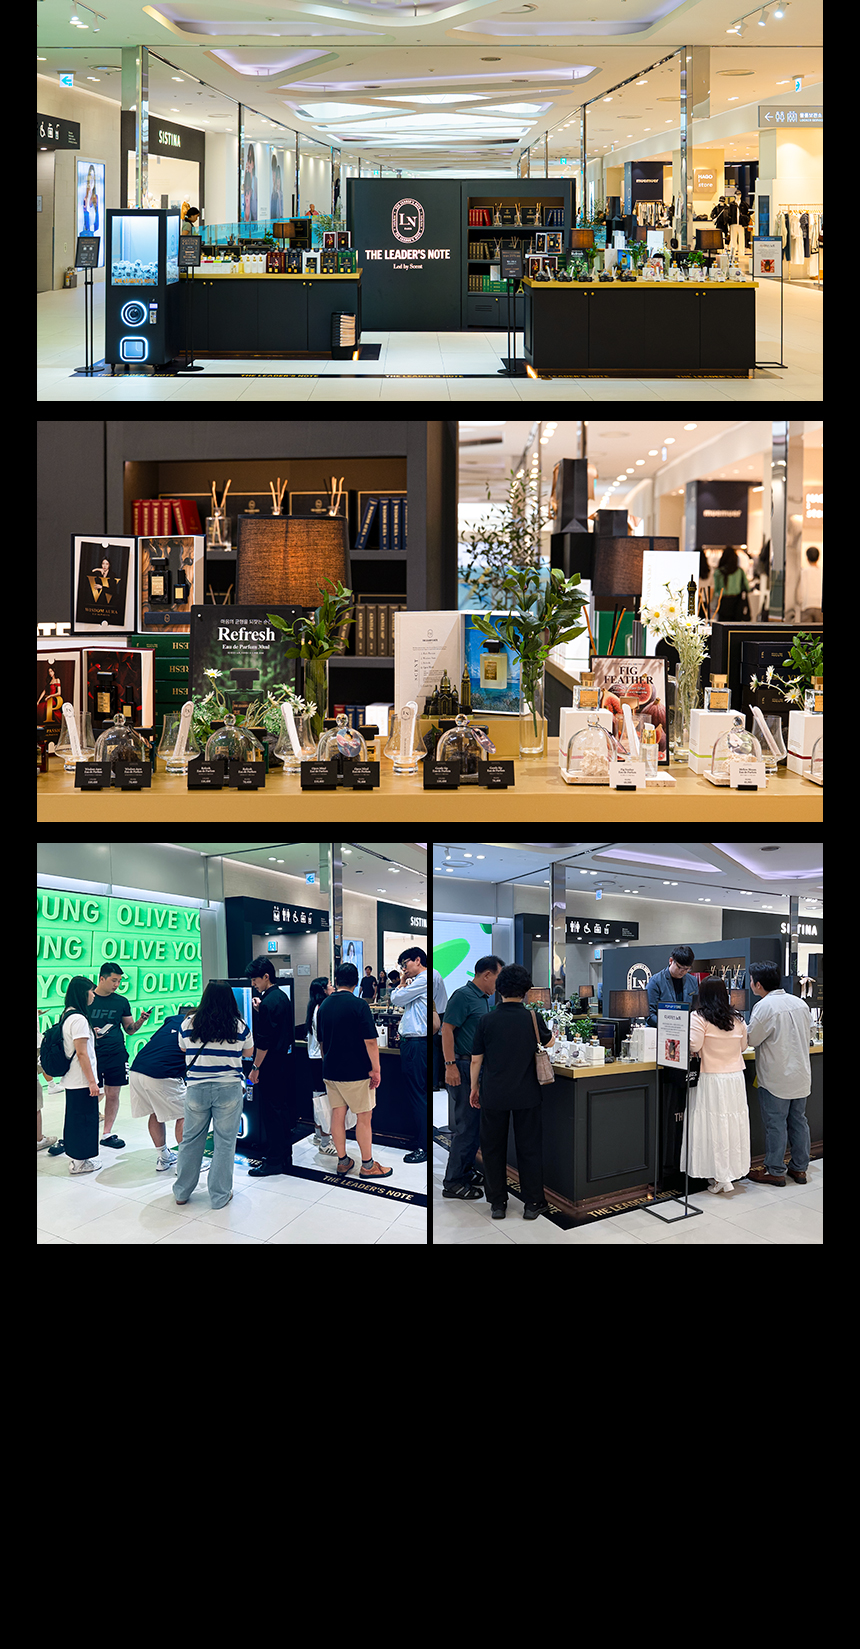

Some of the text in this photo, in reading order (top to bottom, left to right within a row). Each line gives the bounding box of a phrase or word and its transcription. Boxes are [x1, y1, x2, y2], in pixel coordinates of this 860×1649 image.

[158, 130, 181, 147] SISTINA
[399, 213, 417, 227] LN
[365, 250, 450, 260] THE LEADER'S NOTE
[217, 627, 275, 641] Refresh
[620, 667, 638, 675] FIG
[604, 676, 653, 684] FEATHER
[37, 896, 99, 923] UNG
[117, 904, 178, 929] OLIVE
[780, 922, 818, 936] SITINA
[37, 935, 82, 960] NG
[102, 938, 166, 960] OLIVE
[143, 973, 199, 993] OLIVE
[91, 1009, 116, 1019] UFC
[675, 1112, 684, 1122] TH
[323, 1175, 414, 1200] THE LEADER'S NOTE
[587, 1207, 612, 1217] THE
